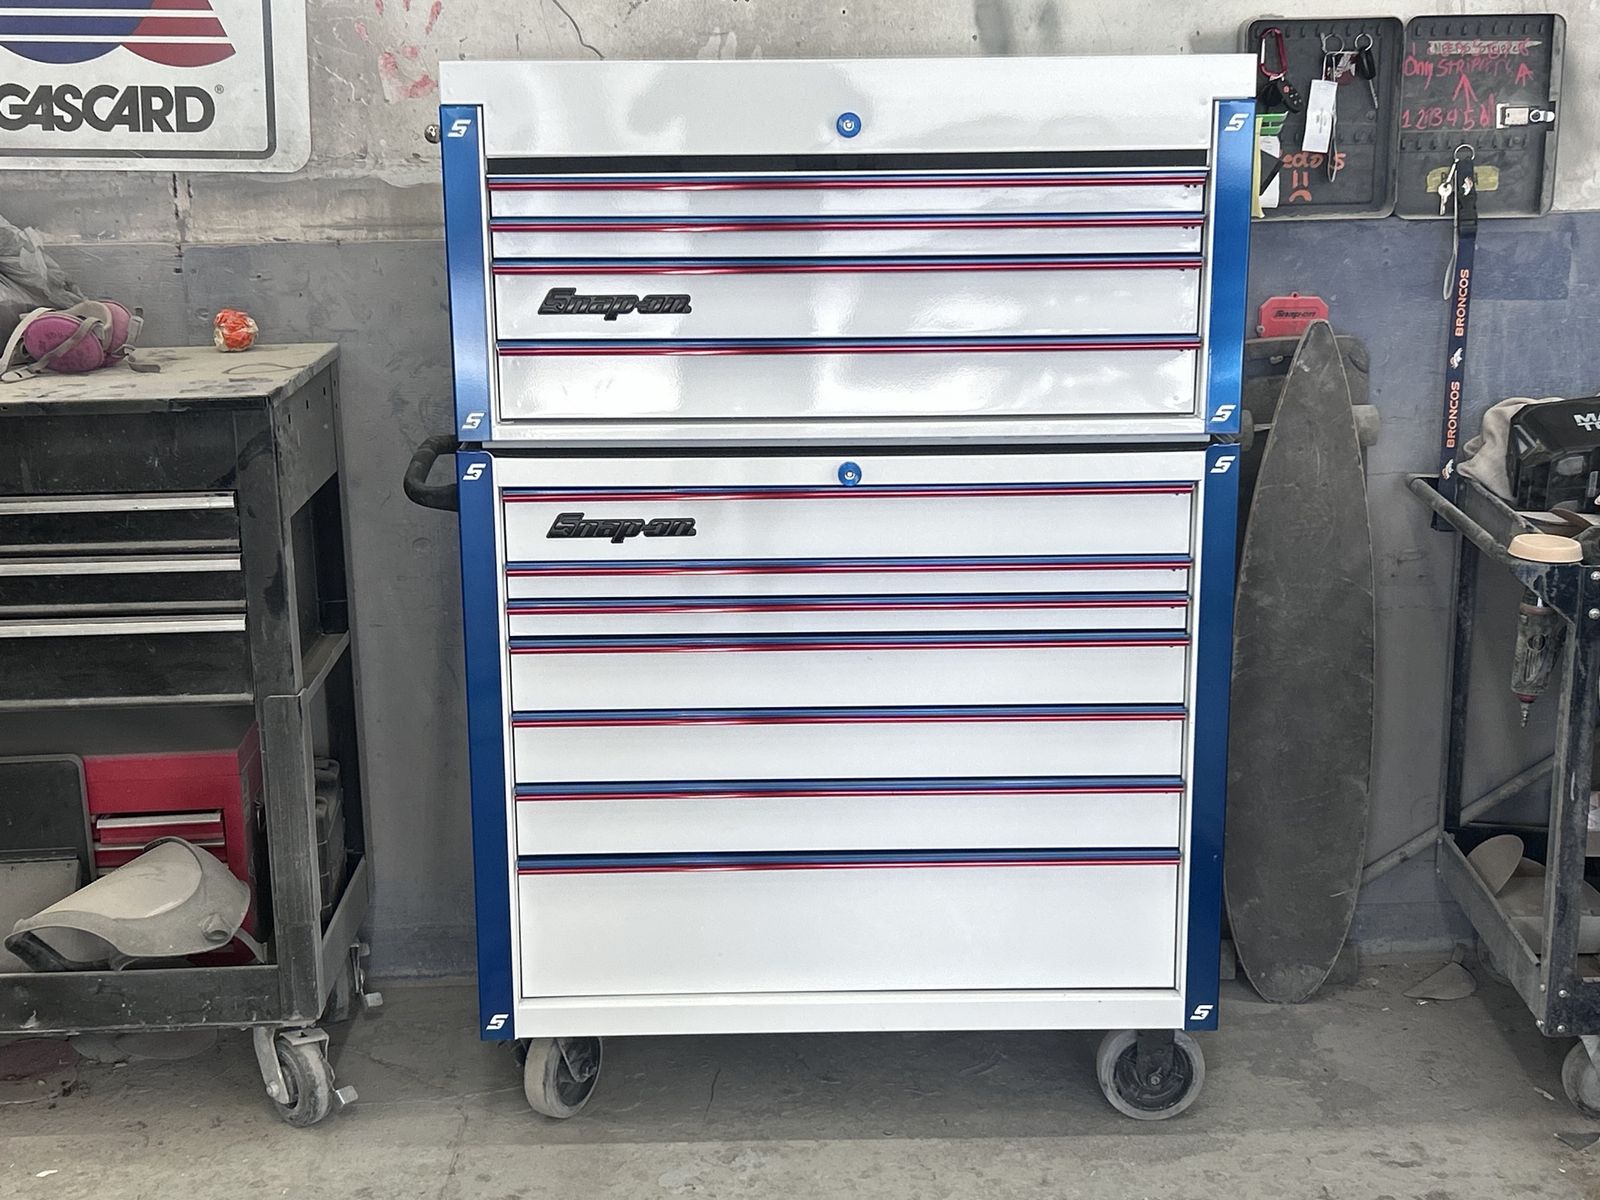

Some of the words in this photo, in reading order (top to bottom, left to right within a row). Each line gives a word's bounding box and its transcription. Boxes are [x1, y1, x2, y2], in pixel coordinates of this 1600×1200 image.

[538, 287, 693, 322] Snap-on
[1455, 268, 1470, 337] BRONCOS
[1446, 381, 1460, 448] BRONCOS
[546, 512, 697, 544] Snap-on
